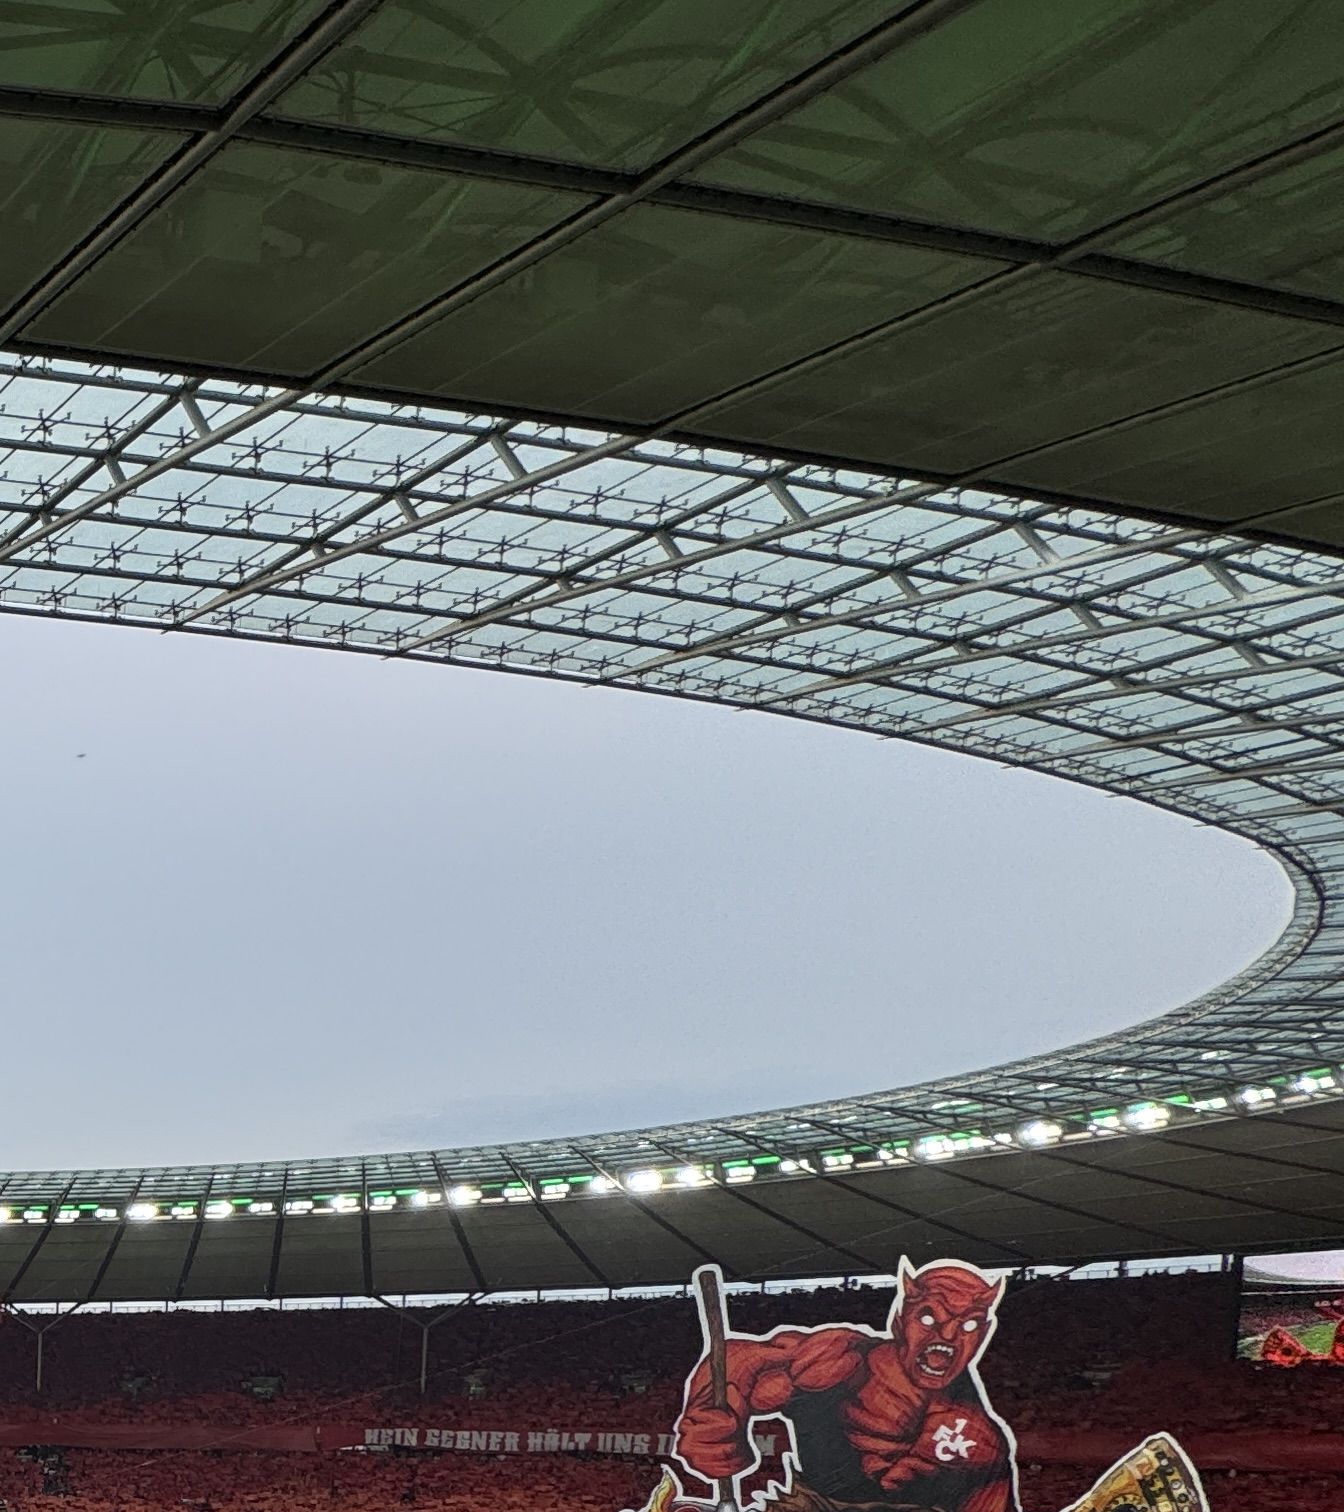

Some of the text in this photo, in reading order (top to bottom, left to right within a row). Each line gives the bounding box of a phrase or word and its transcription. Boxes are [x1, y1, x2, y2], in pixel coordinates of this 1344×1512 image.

[424, 1429, 520, 1450] GEGNER
[527, 1429, 592, 1451] HÄLT
[597, 1433, 651, 1454] UNS
